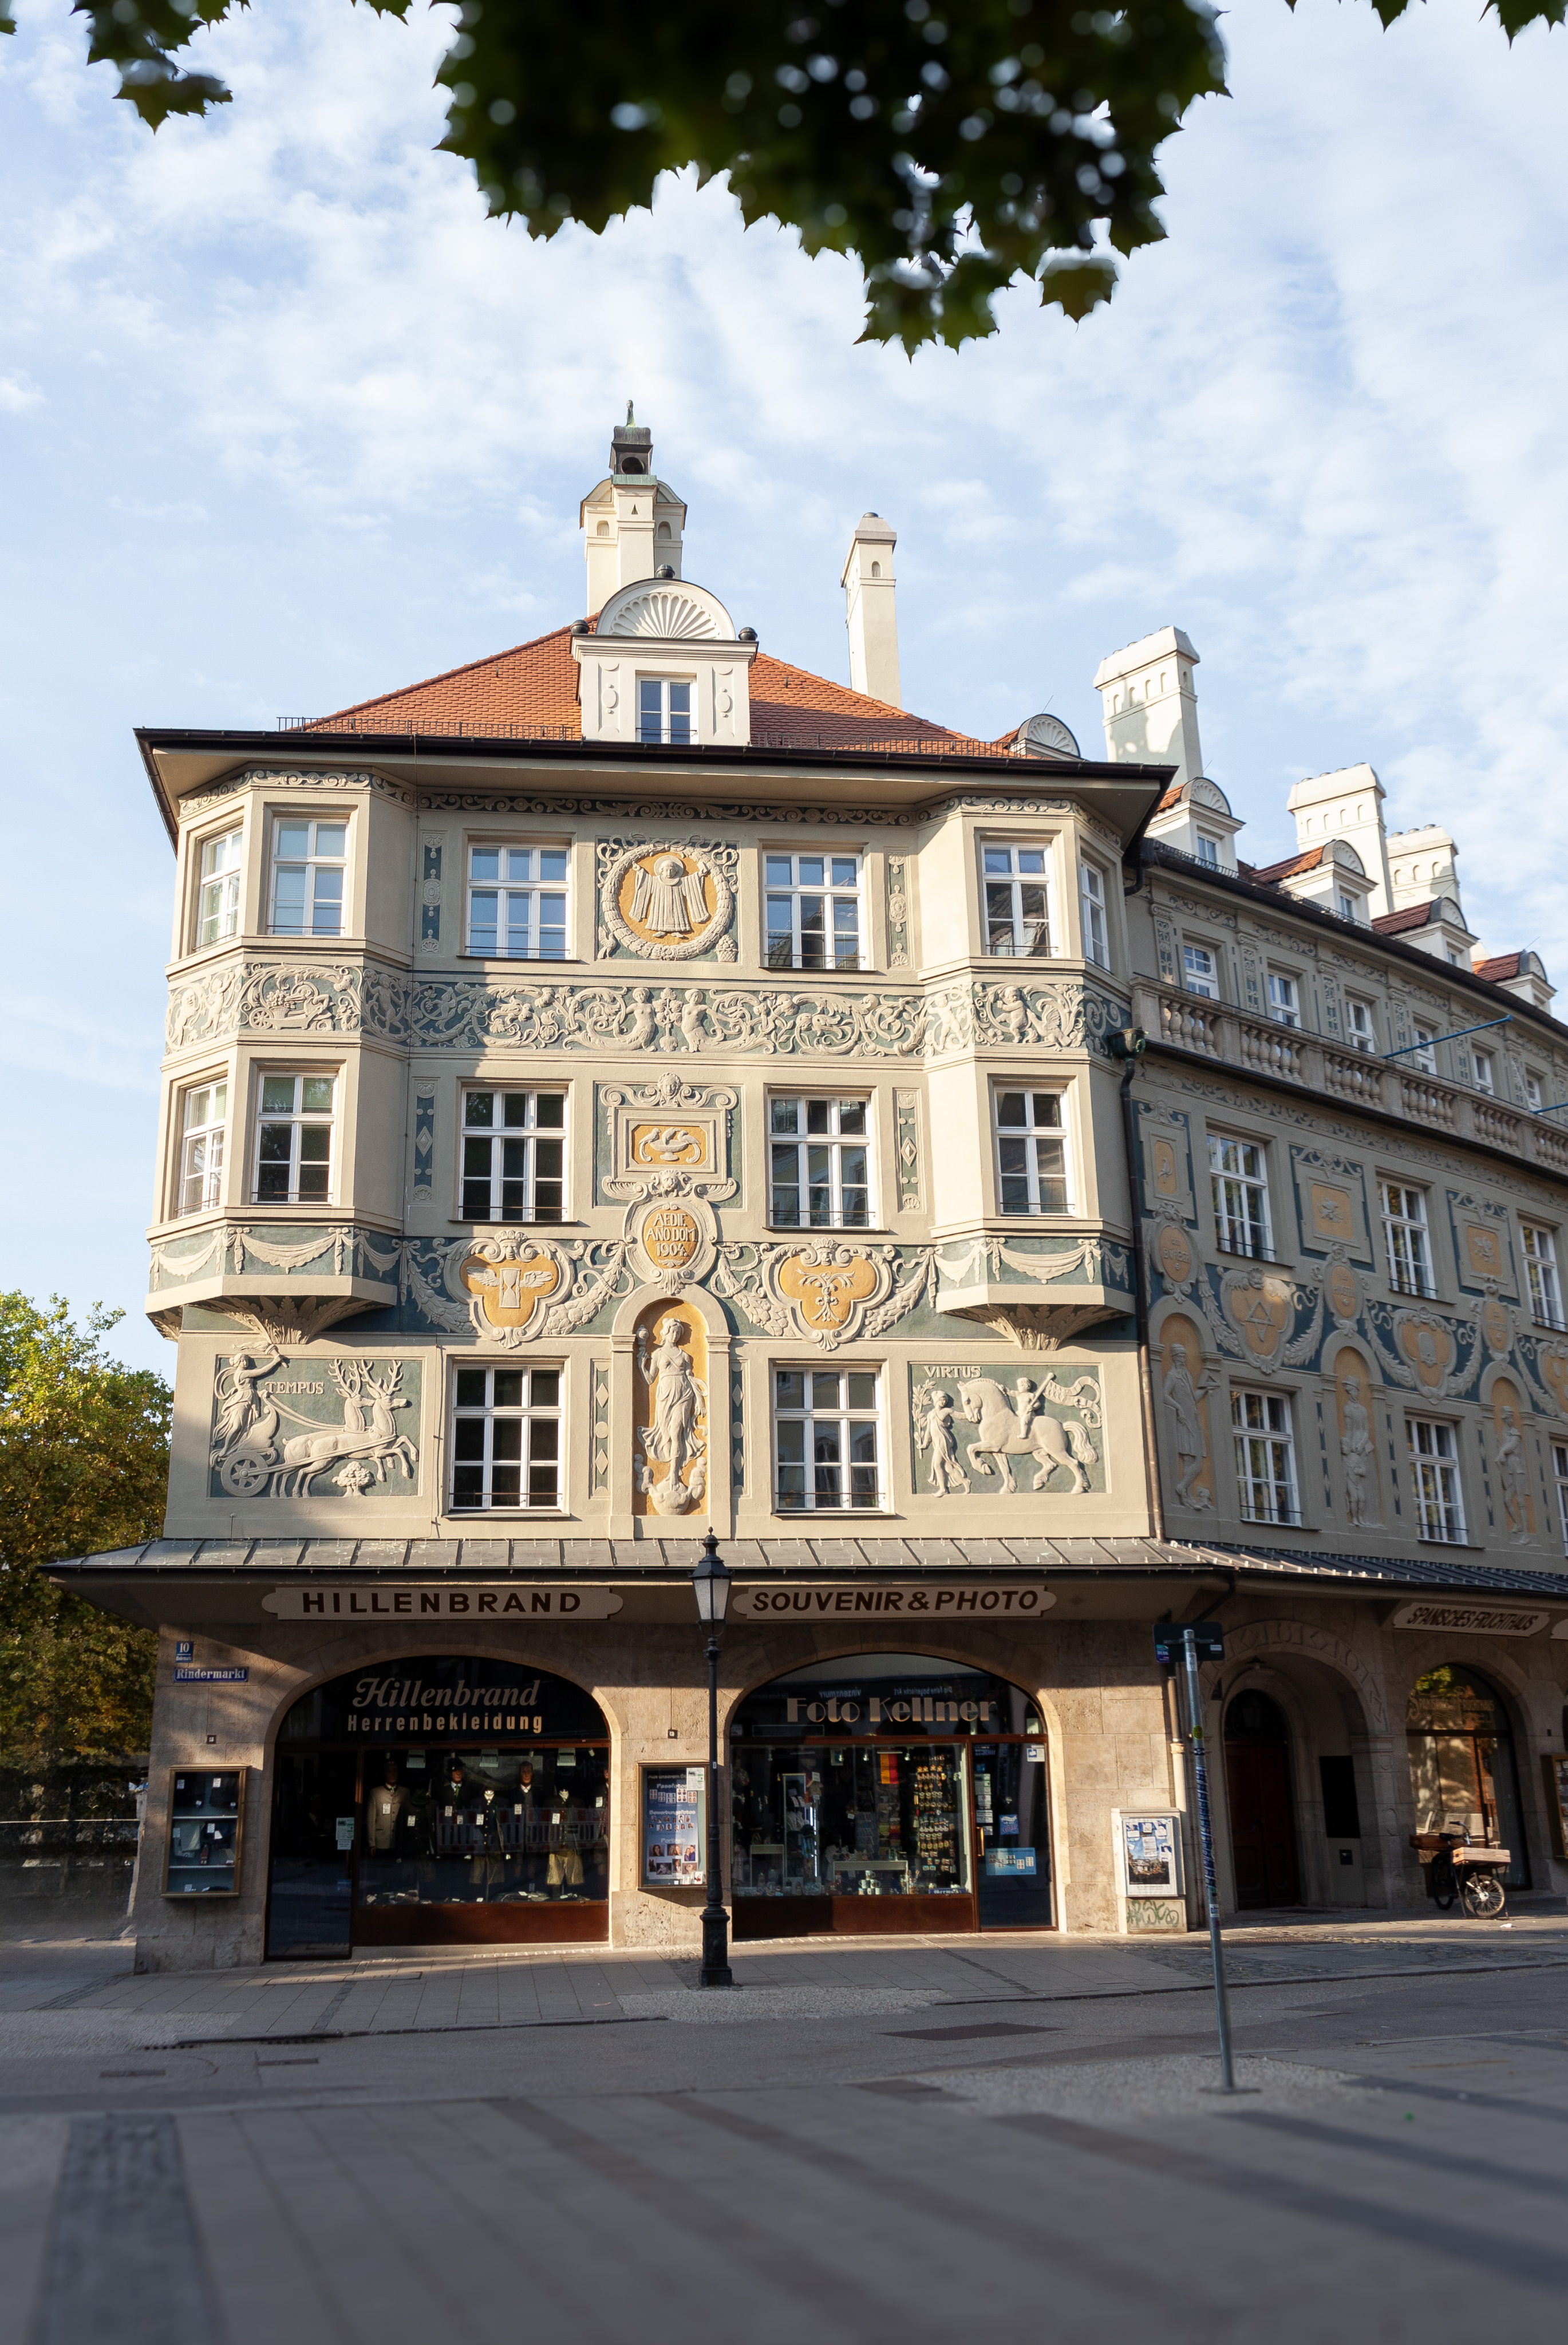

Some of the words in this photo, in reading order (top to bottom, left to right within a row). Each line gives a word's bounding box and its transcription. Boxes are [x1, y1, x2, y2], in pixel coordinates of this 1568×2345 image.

[653, 1213, 687, 1226] AEDIF.
[923, 1365, 982, 1378] VIRTUS
[264, 1381, 325, 1395] TEMPUS
[302, 1592, 580, 1613] HILLENBRAND
[179, 1643, 189, 1653] 10
[176, 1668, 245, 1679] Rindermarkt
[351, 1677, 540, 1708] Hillenbrand
[787, 1697, 860, 1723] Foto
[869, 1697, 997, 1723] Kellner
[347, 1713, 542, 1734] Herrenbekleidung
